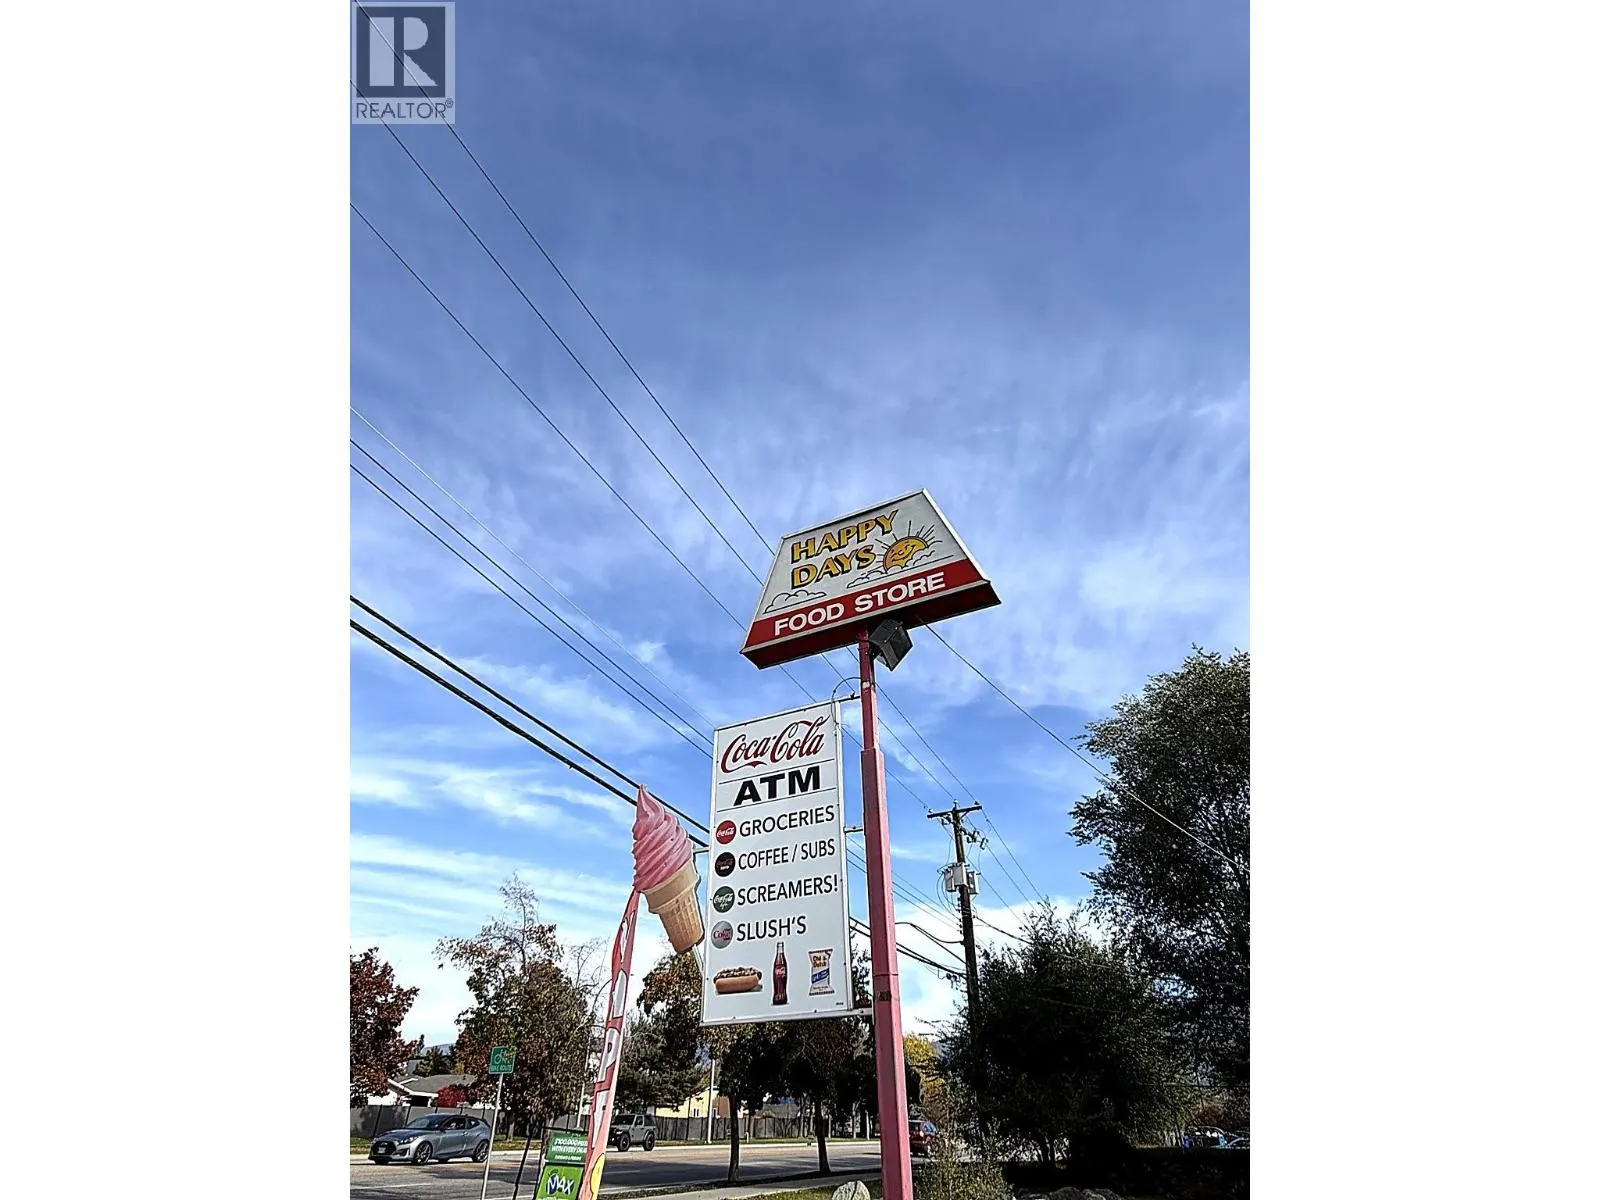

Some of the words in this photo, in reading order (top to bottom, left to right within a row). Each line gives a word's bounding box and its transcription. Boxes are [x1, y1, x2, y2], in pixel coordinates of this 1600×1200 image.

[791, 509, 899, 564] HAPPY
[791, 544, 876, 590] DAYS
[774, 602, 845, 636] FOOD
[854, 572, 945, 613] STORE
[721, 714, 831, 773] Coca-Cola
[733, 765, 820, 806] ATM
[739, 805, 835, 837] GROCERIES
[738, 846, 789, 870] COFFEE
[801, 839, 835, 860] SUBS
[737, 874, 838, 906] SCREAMERS!
[736, 915, 807, 942] SLUSH'S
[547, 1173, 574, 1196] MAX
